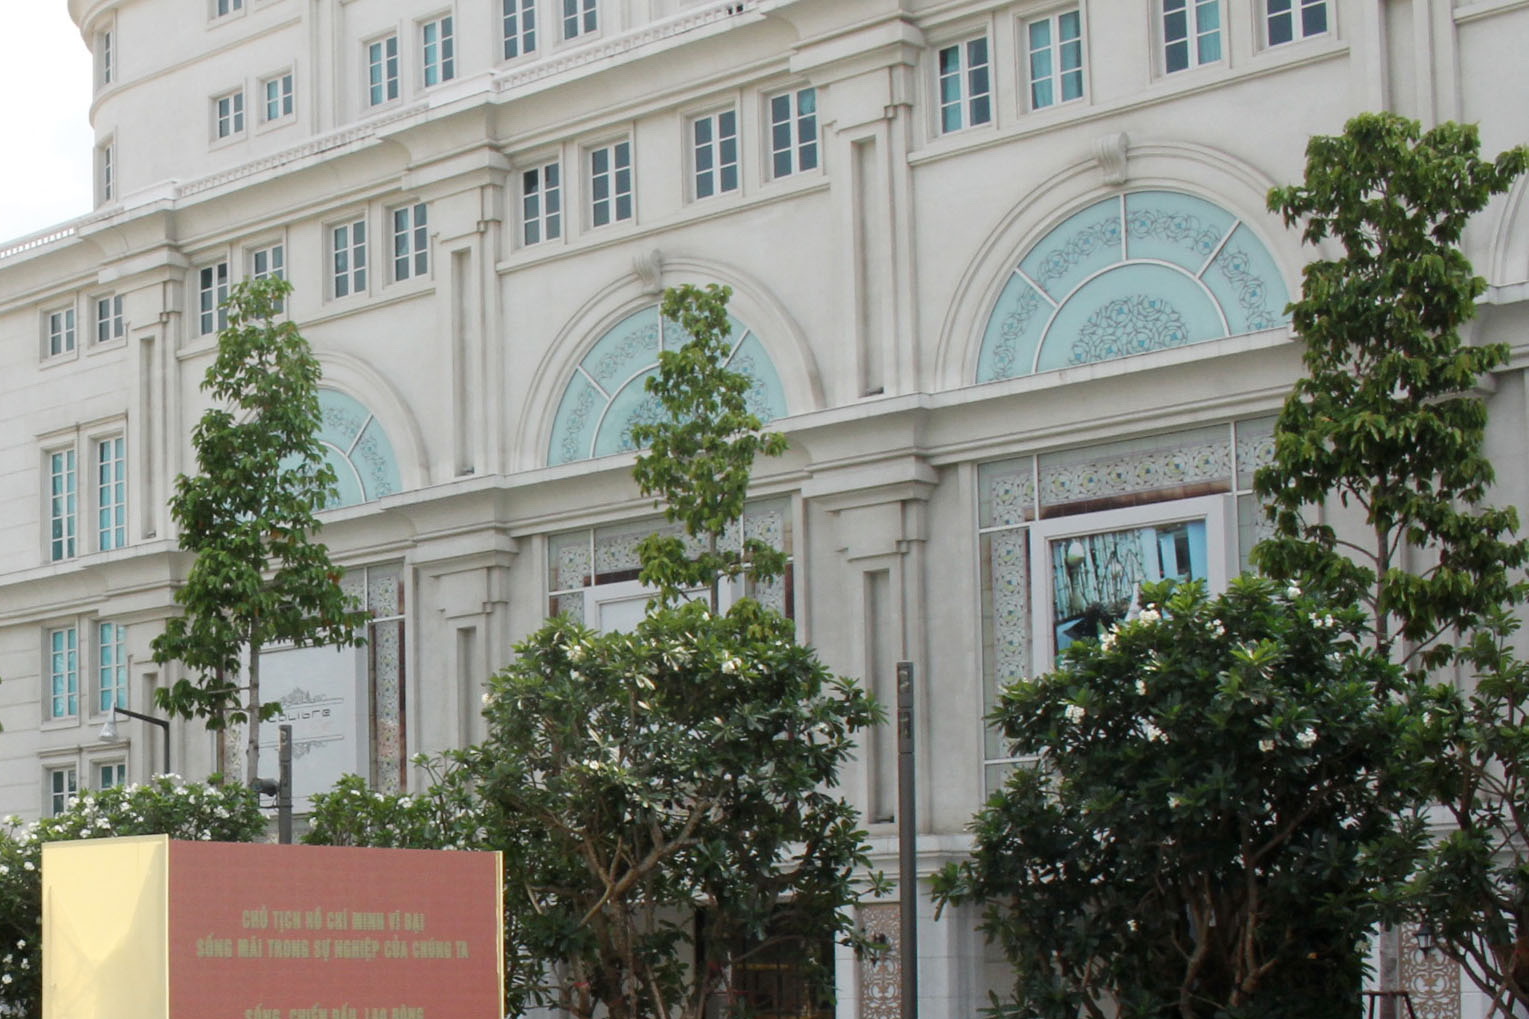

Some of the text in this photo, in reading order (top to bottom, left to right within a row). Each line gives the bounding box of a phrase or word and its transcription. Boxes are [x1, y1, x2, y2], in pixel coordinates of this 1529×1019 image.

[242, 905, 269, 929] CHỦ
[272, 909, 302, 933] TỊCH
[352, 911, 385, 931] MINH
[268, 939, 310, 958] TRONG
[455, 941, 470, 958] TA
